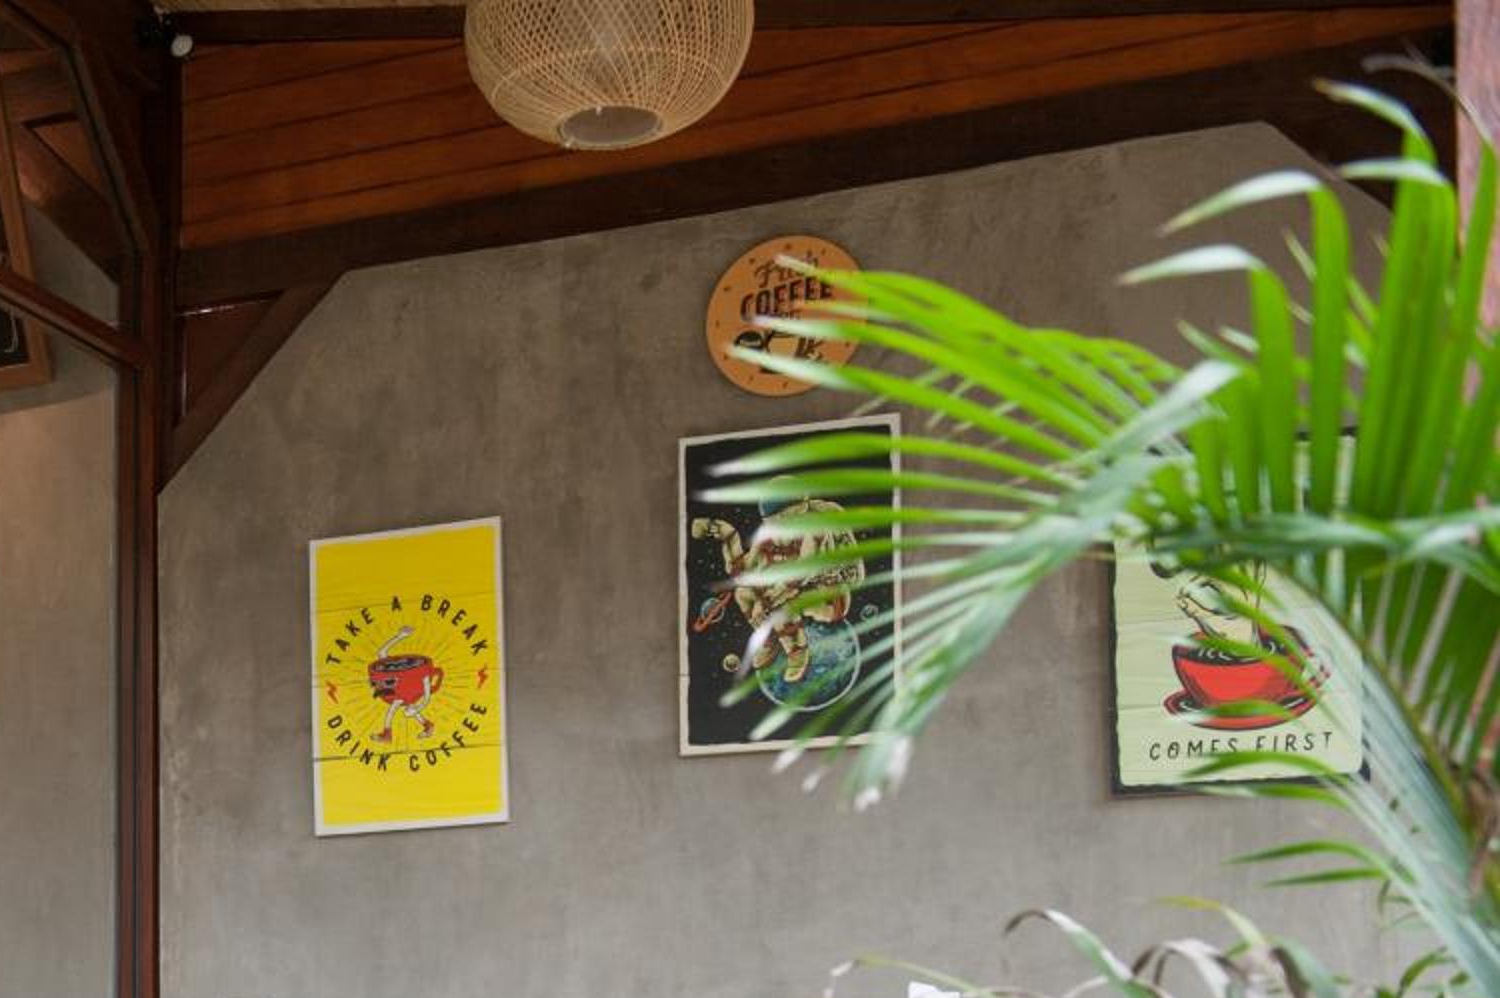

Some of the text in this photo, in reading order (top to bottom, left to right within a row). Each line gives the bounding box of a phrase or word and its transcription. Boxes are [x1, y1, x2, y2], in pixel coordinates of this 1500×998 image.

[326, 595, 488, 665] TAKE A BREAK
[327, 703, 488, 772] DRINK COFFEE
[1150, 732, 1332, 760] COMES FIRST
